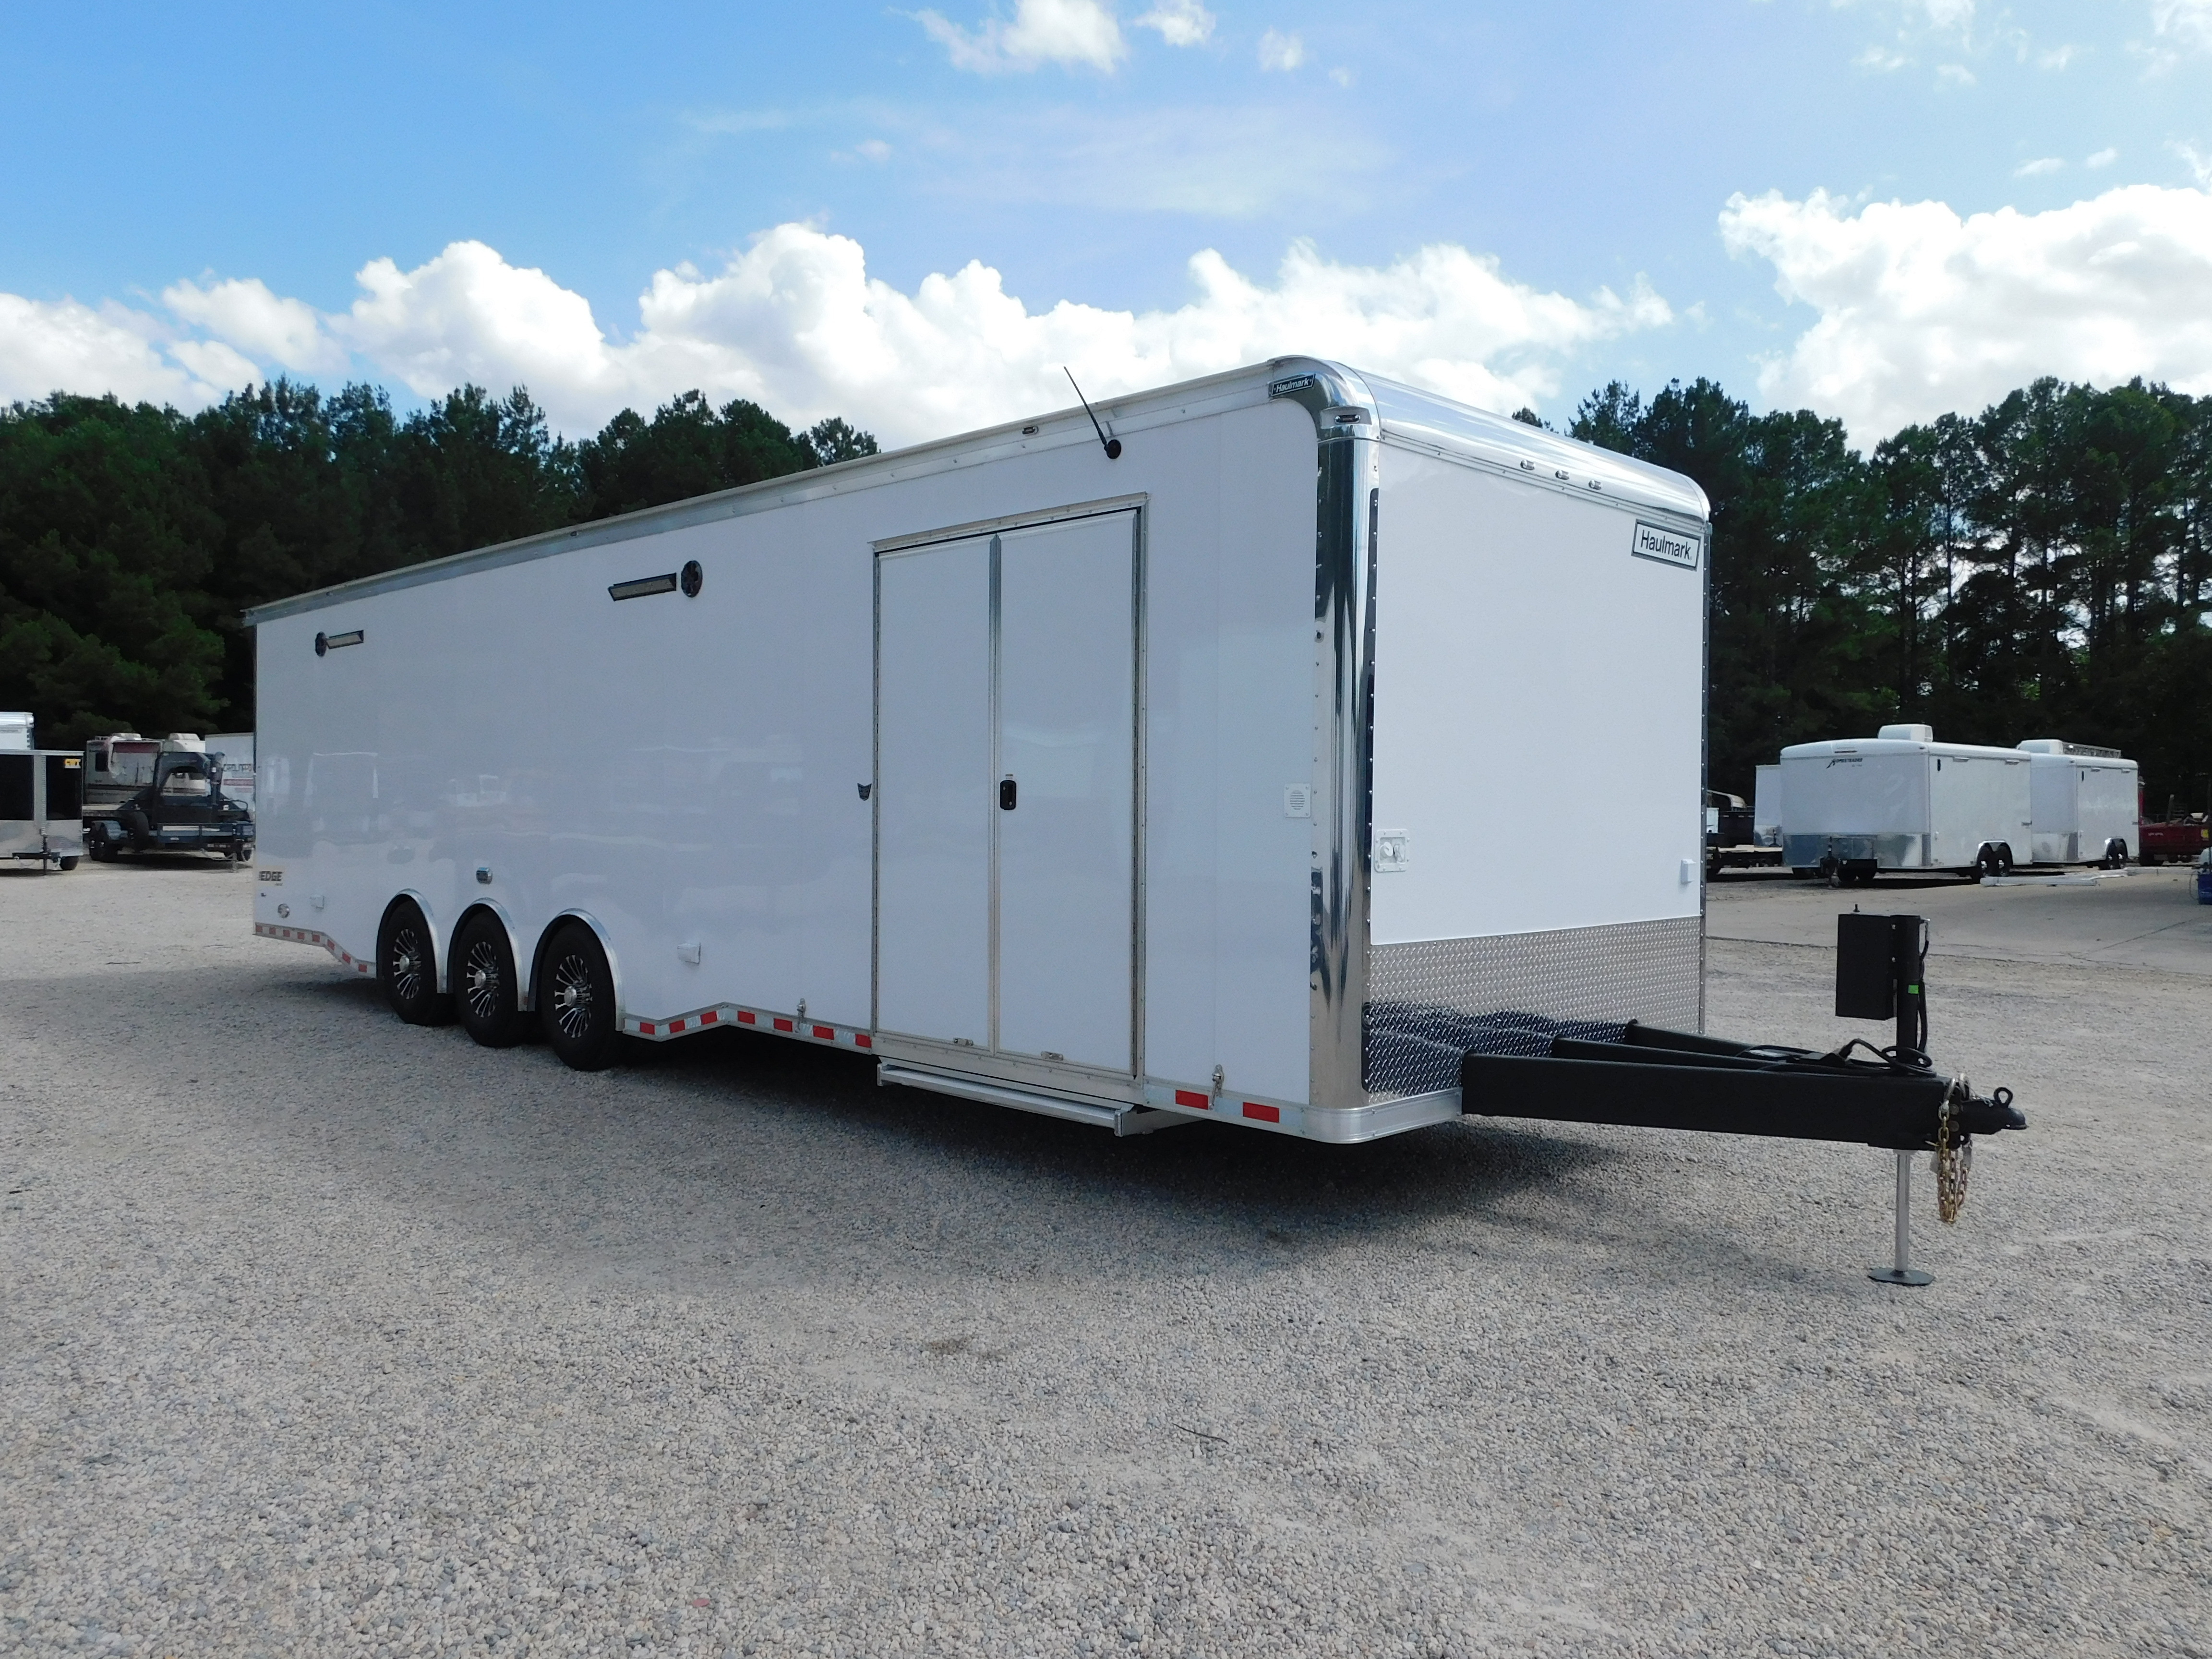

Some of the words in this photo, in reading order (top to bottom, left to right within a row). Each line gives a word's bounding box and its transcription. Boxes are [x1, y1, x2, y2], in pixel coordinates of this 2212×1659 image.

[1276, 377, 1310, 393] Haulmark
[1640, 529, 1691, 560] Haulmark
[260, 871, 283, 881] EDGE
